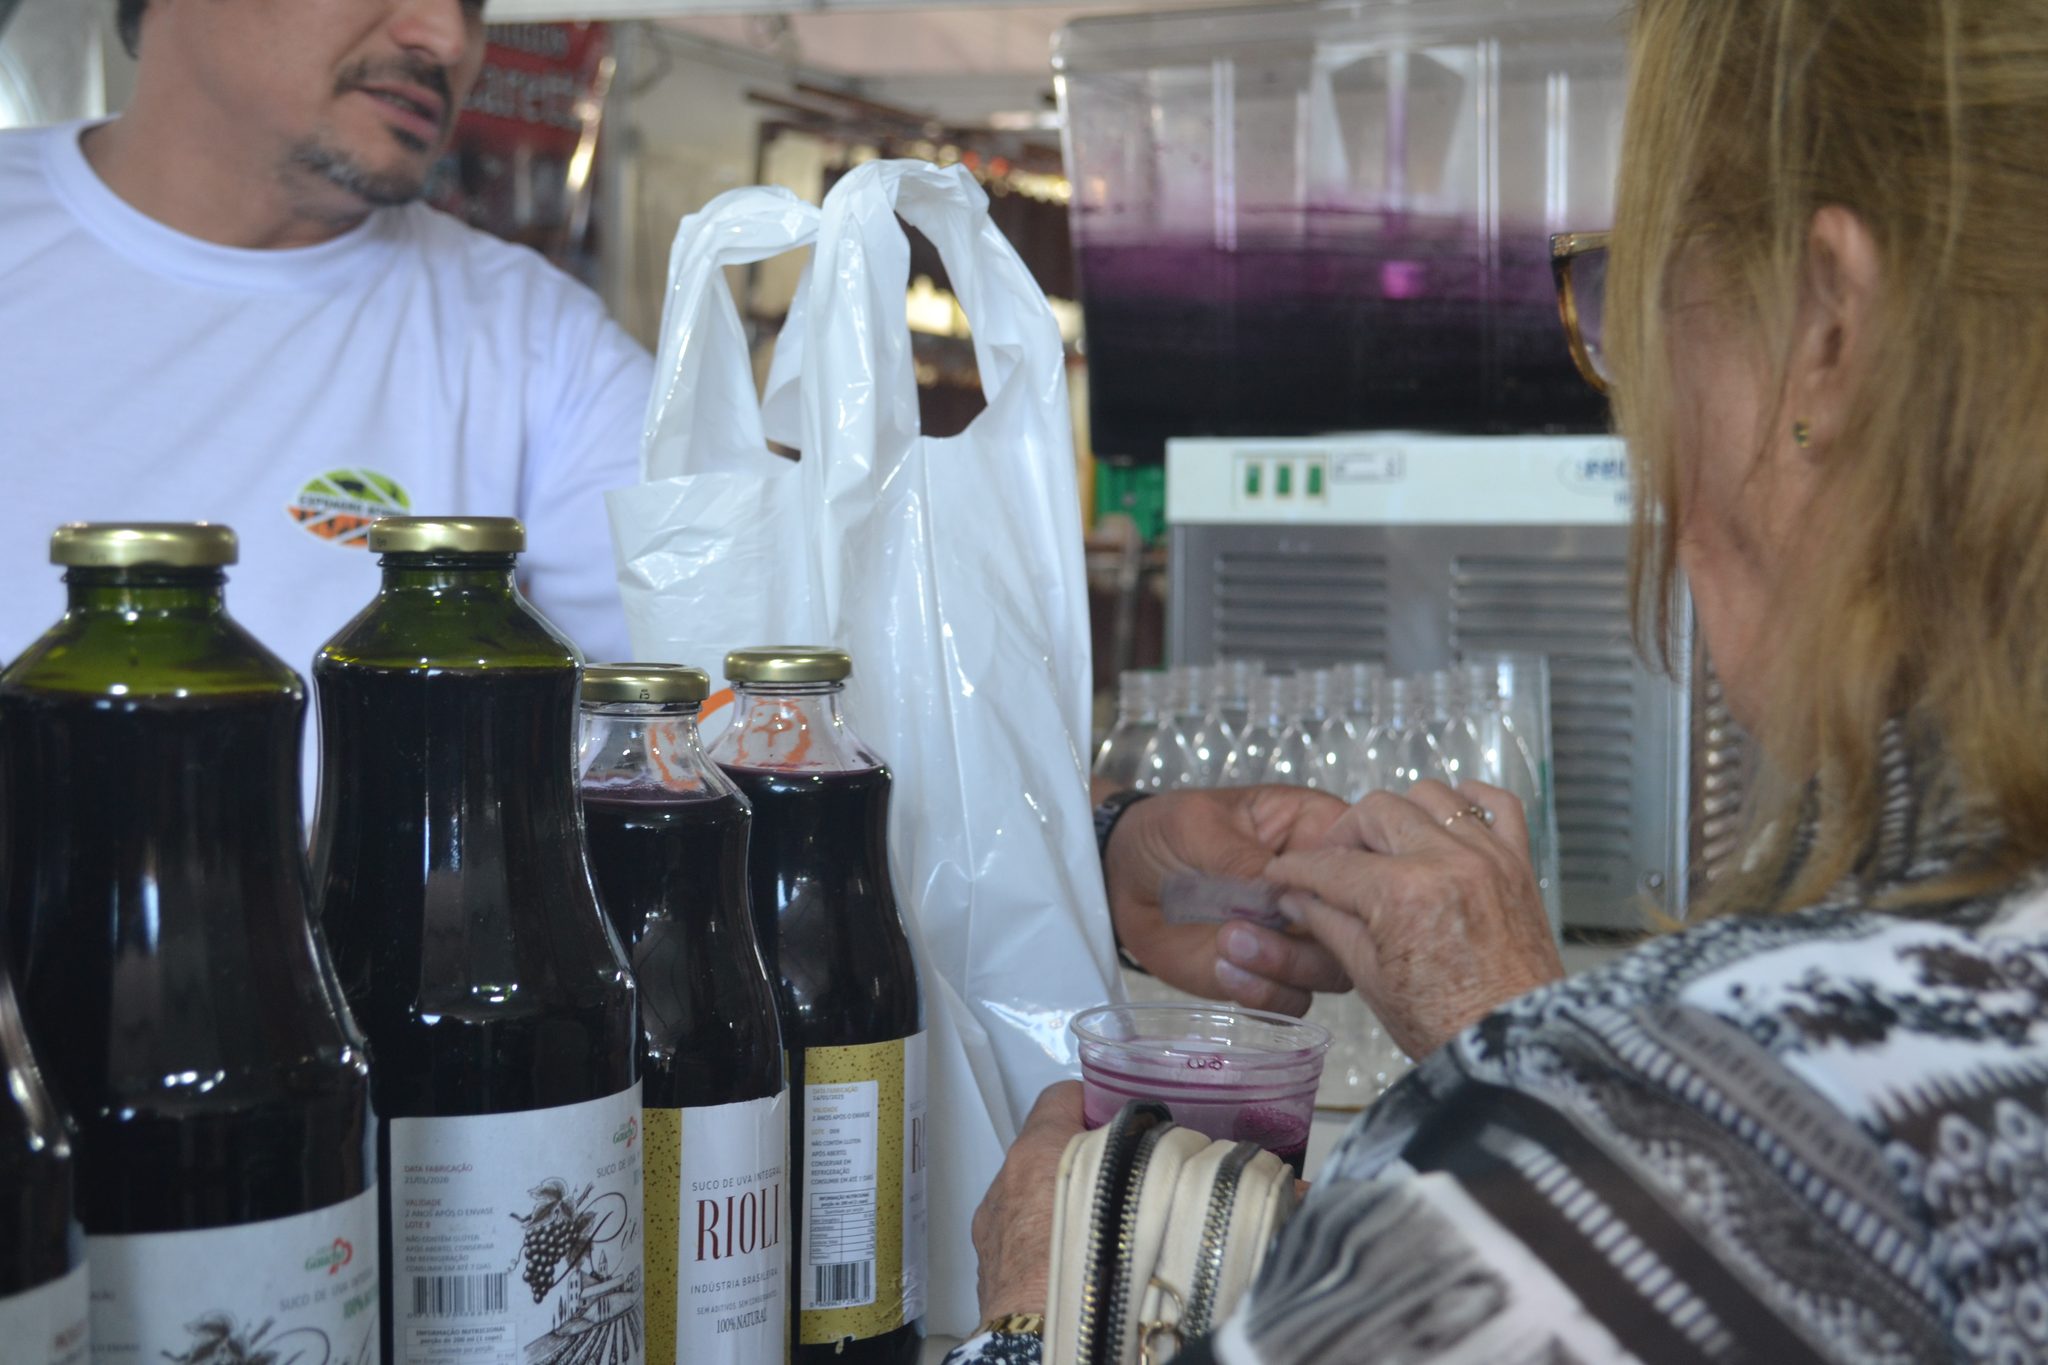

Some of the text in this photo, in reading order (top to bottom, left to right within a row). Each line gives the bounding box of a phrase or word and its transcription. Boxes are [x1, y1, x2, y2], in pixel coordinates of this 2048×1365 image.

[404, 1162, 473, 1174] DATA FABRICAÇÃO
[597, 1163, 617, 1179] SUCO
[692, 1180, 720, 1192] SUCO
[722, 1177, 734, 1188] DE
[736, 1174, 752, 1186] UVA
[411, 1209, 433, 1217] ANOS
[465, 1207, 494, 1216] ENVASE
[405, 1221, 424, 1229] LOTE
[694, 1183, 780, 1262] RIOLI
[690, 1279, 740, 1295] INDÚSTRIA
[280, 1293, 310, 1312] SUCO
